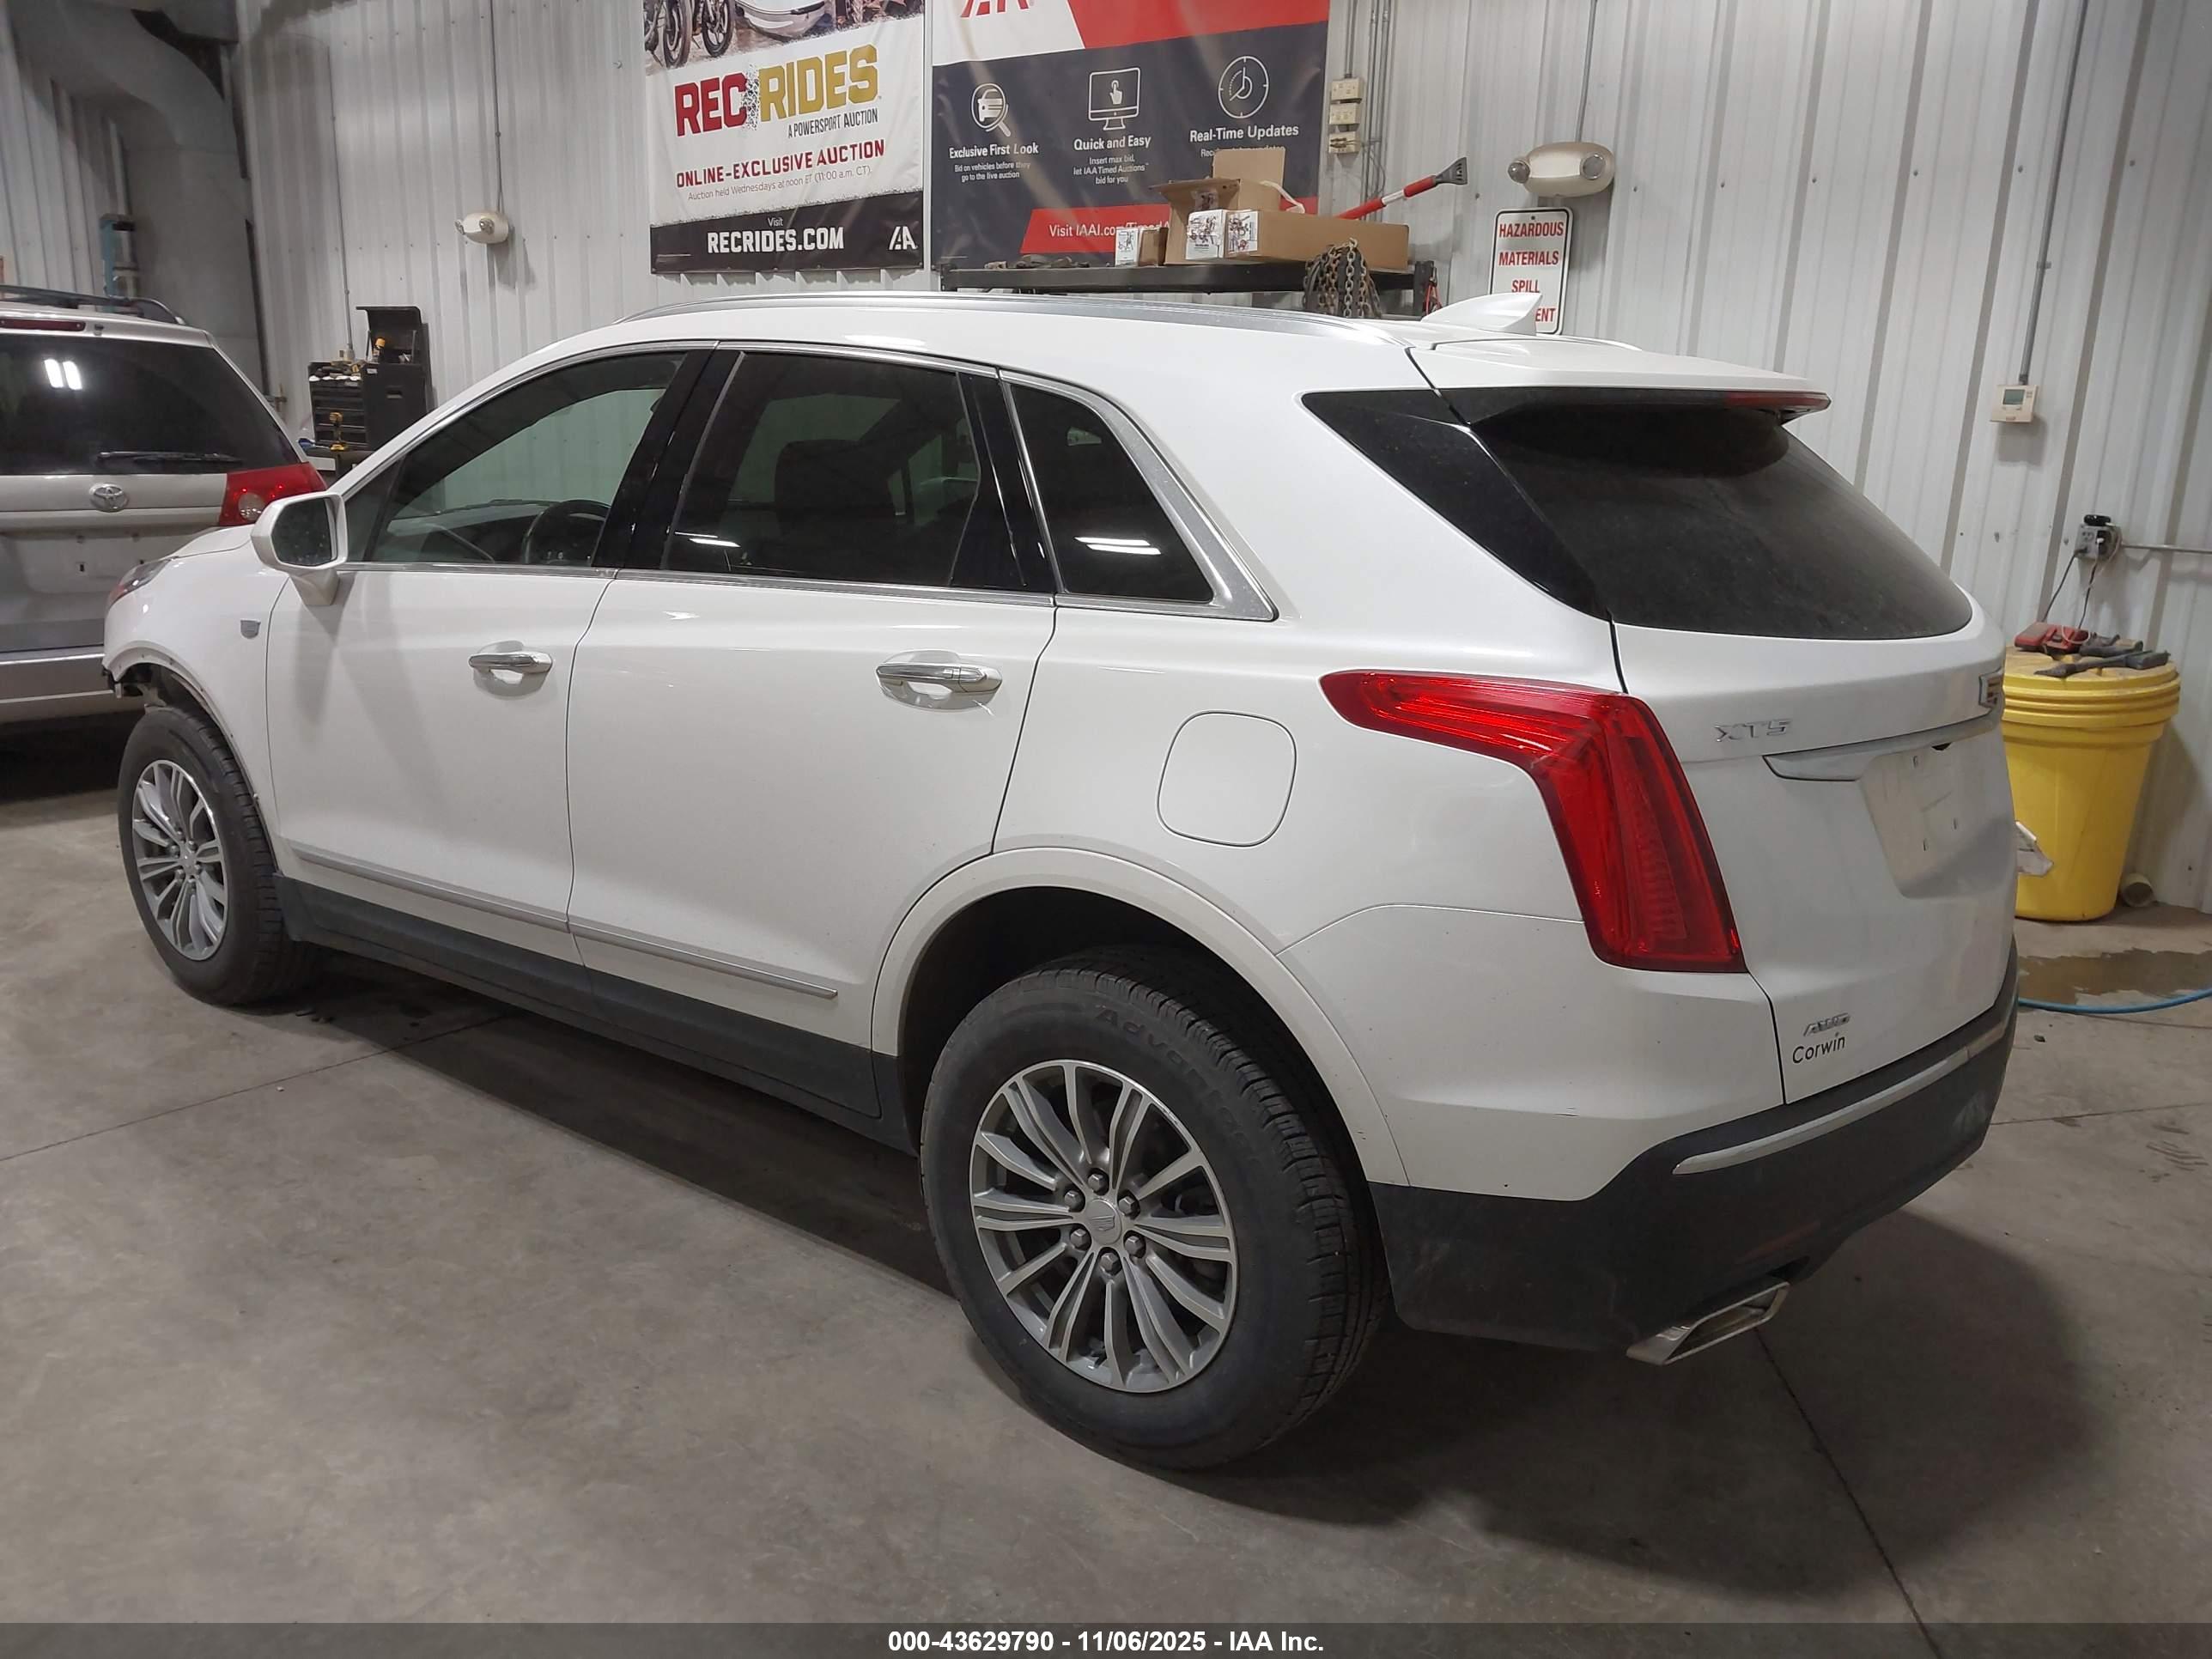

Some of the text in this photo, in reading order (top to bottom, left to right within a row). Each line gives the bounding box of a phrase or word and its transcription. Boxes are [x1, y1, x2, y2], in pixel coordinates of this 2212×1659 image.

[759, 44, 879, 122] RIDES
[788, 108, 878, 138] A POWERSPORT AUCTION
[1189, 125, 1299, 143] Real-Time Updates
[949, 142, 1040, 159] Exclusive First Look
[1073, 135, 1152, 151] Quick and Easy
[677, 139, 885, 188] ONLINE-EXCLUSIVE AUCTION
[972, 162, 995, 171] vehicles
[996, 161, 1015, 170] before
[1089, 156, 1108, 165] Insert
[976, 172, 985, 180] the
[1073, 167, 1082, 175] let
[1098, 165, 1117, 174] Timed
[1116, 176, 1129, 185] you
[688, 191, 714, 201] Auction
[715, 188, 730, 198] held
[731, 181, 776, 196] Wednesdays
[786, 178, 804, 186] noon
[768, 217, 783, 227] Visit
[1049, 223, 1073, 237] Visit
[1499, 222, 1564, 238] HAZARDOUS
[708, 227, 844, 253] RECRIDES.COM
[1498, 251, 1559, 266] MATERIALS
[1511, 279, 1540, 293] SPILL
[1714, 718, 1792, 743] XT5
[1792, 1031, 1845, 1064] Corwin
